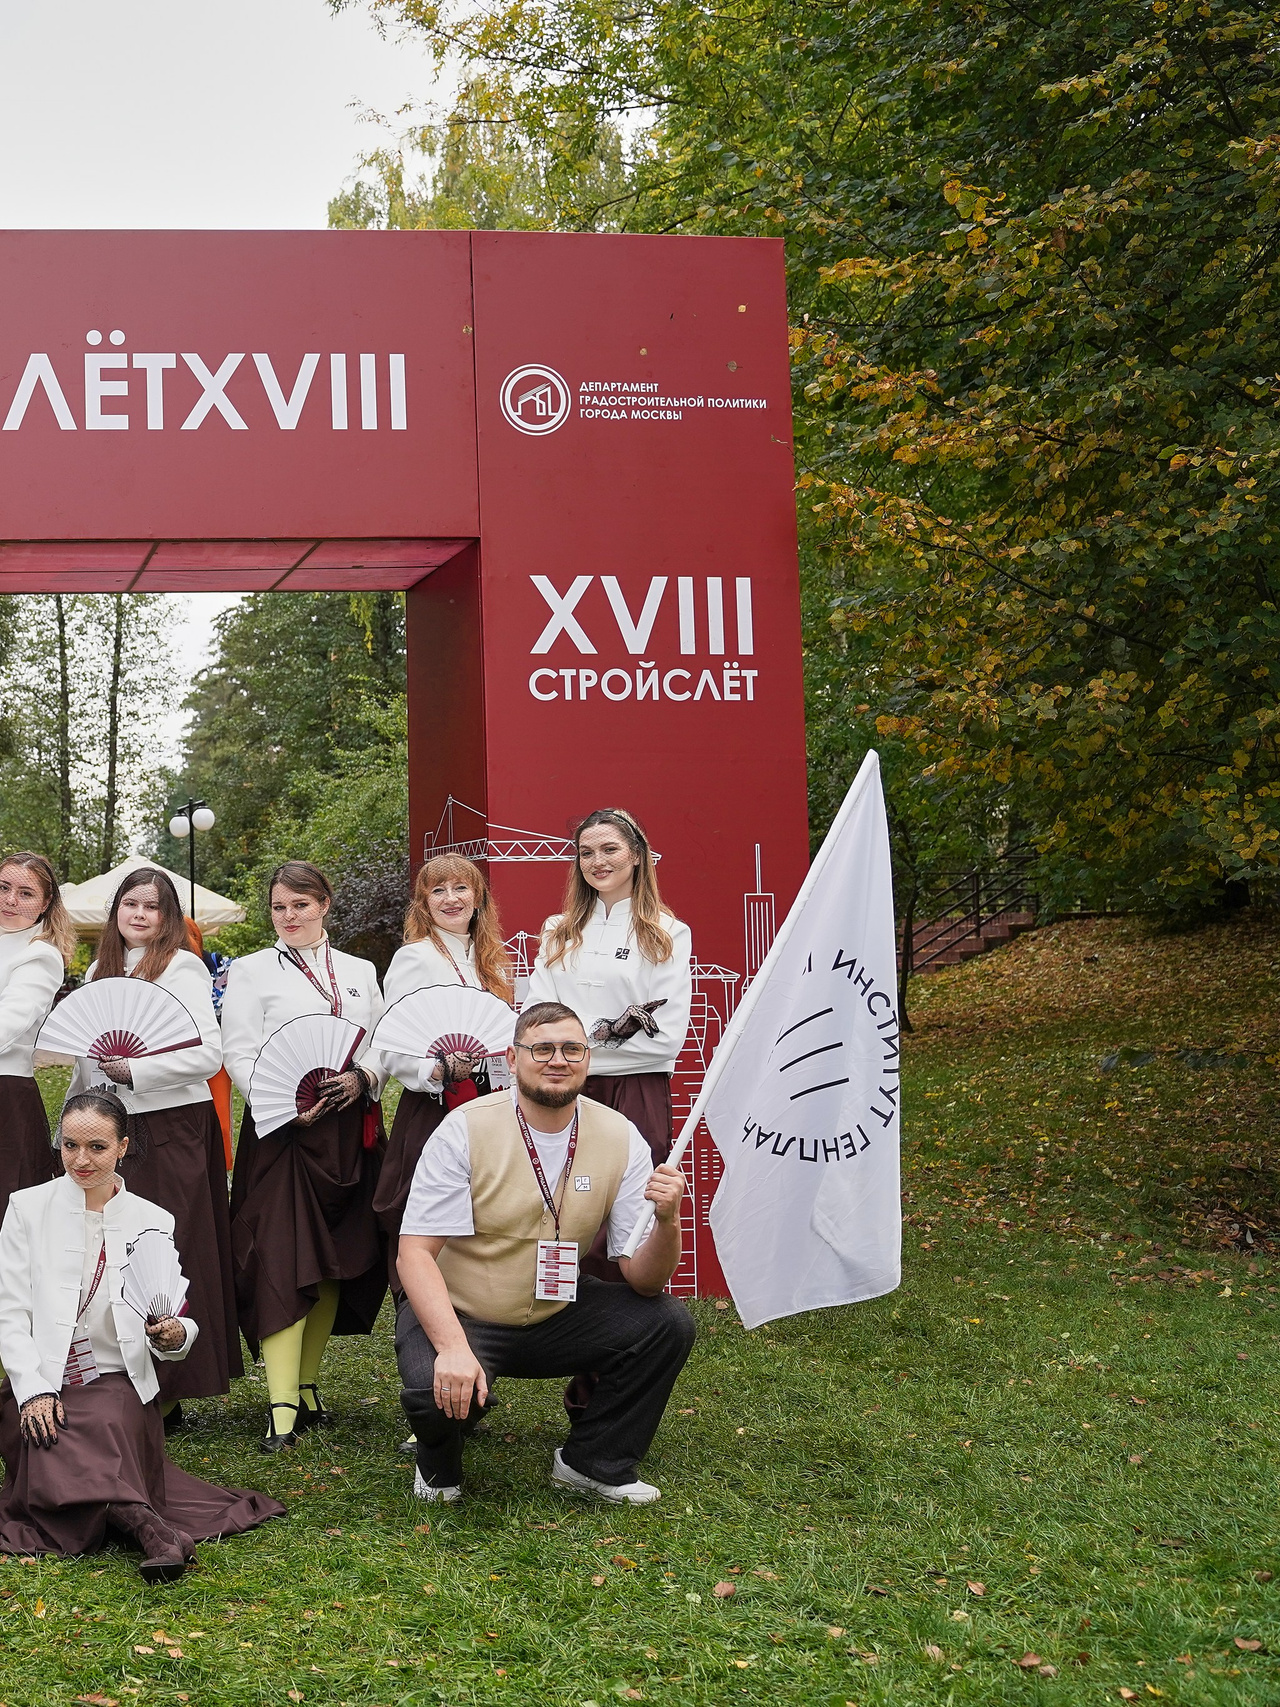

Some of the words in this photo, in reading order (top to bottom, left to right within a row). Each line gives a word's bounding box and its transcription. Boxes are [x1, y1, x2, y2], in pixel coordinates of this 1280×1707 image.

[579, 381, 659, 393] ДЕПАРТАМЕНТ
[579, 395, 704, 409] ГРАДОСТРОИТЕЛЬНОЙ
[707, 398, 767, 409] ПОЛИТИКИ
[579, 408, 628, 421] ГОРОДА
[630, 409, 682, 421] МОСКВЫ
[529, 574, 754, 656] XVIII
[528, 661, 759, 702] СТРОЙСЛЁТ
[741, 1116, 871, 1163] ГЕНПЛАН
